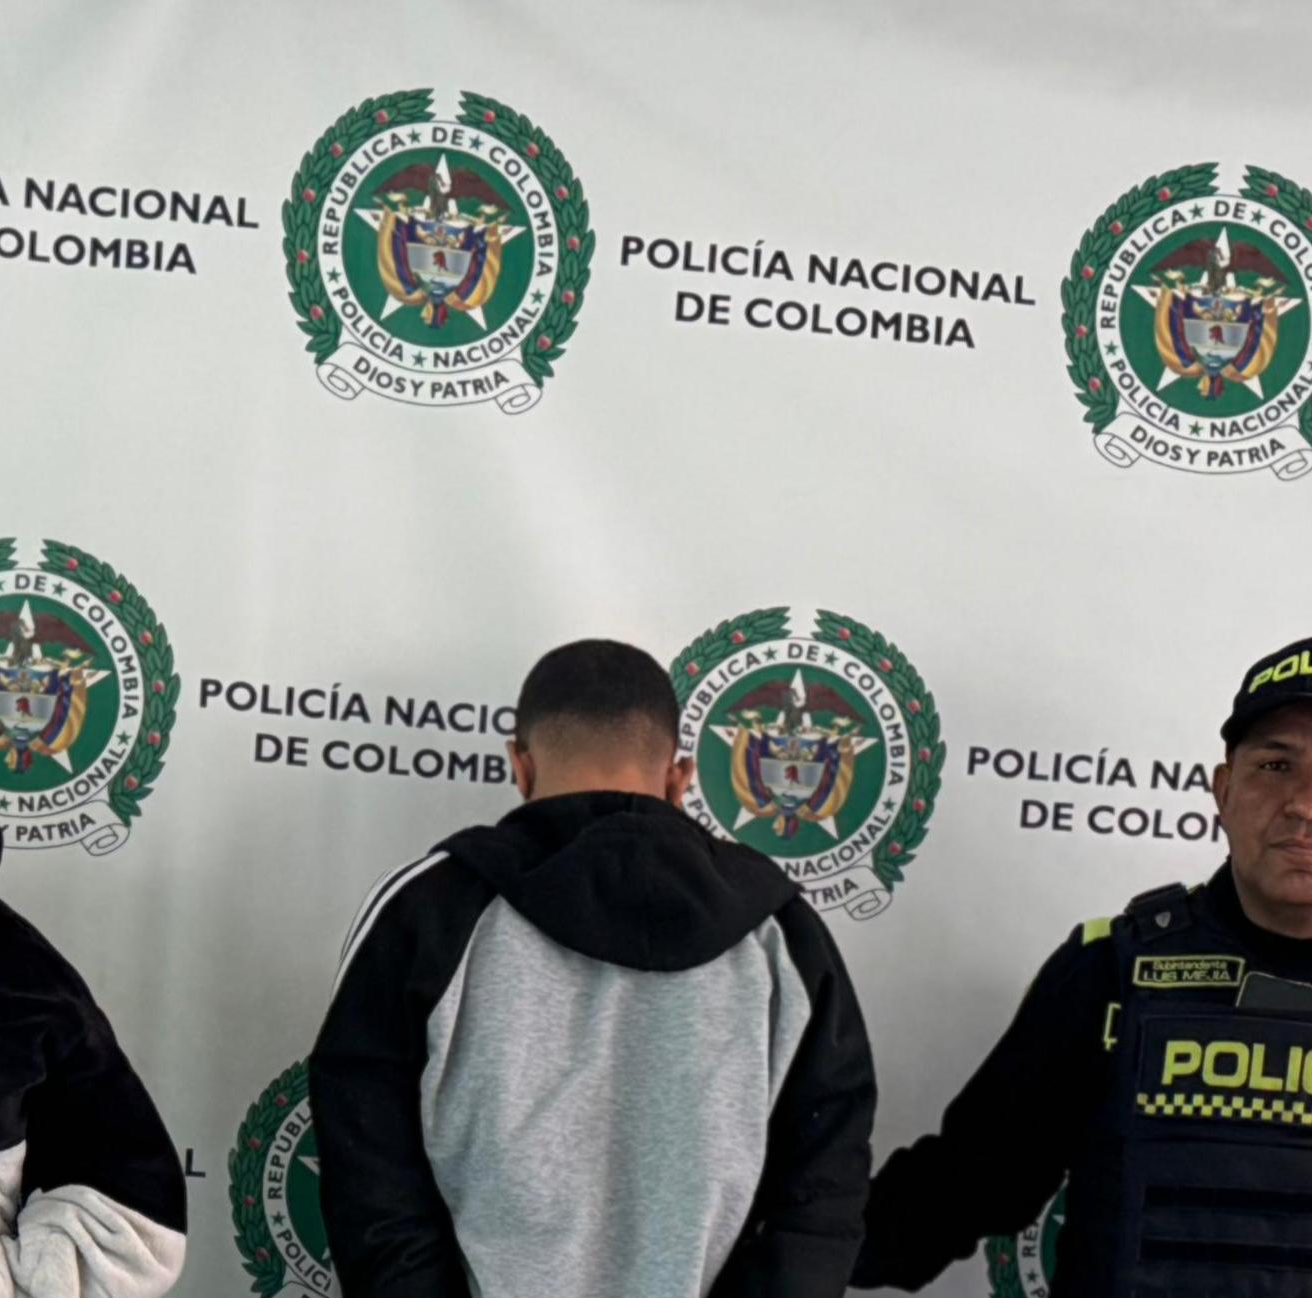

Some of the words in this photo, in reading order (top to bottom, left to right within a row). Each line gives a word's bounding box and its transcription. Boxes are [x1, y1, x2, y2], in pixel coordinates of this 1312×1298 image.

[25, 178, 259, 228] NACIONAL
[431, 126, 464, 146] DE
[489, 146, 554, 277] COLOMBIA
[1211, 203, 1244, 222] DE
[621, 236, 793, 281] POLICÍA
[808, 255, 1035, 305] NACIONAL
[433, 308, 539, 368] NACIONAL
[676, 292, 731, 325] DE
[745, 298, 975, 348] COLOMBIA
[431, 370, 509, 399] PATRIA
[1205, 437, 1283, 465] PATRIA
[14, 574, 47, 594] DE
[72, 593, 139, 719] COLOMBIA
[200, 679, 369, 723] POLICÍA
[385, 696, 516, 735] NACIO
[787, 644, 819, 663] DE
[843, 662, 905, 786] COLOMBIA
[18, 750, 126, 812] NACIONAL
[255, 733, 308, 766] DE
[322, 740, 516, 784] COLOMB
[968, 747, 1136, 787] POLICÍA
[15, 812, 96, 843] PATRIA
[1020, 800, 1073, 831] DE
[1143, 969, 1178, 982] LUIS
